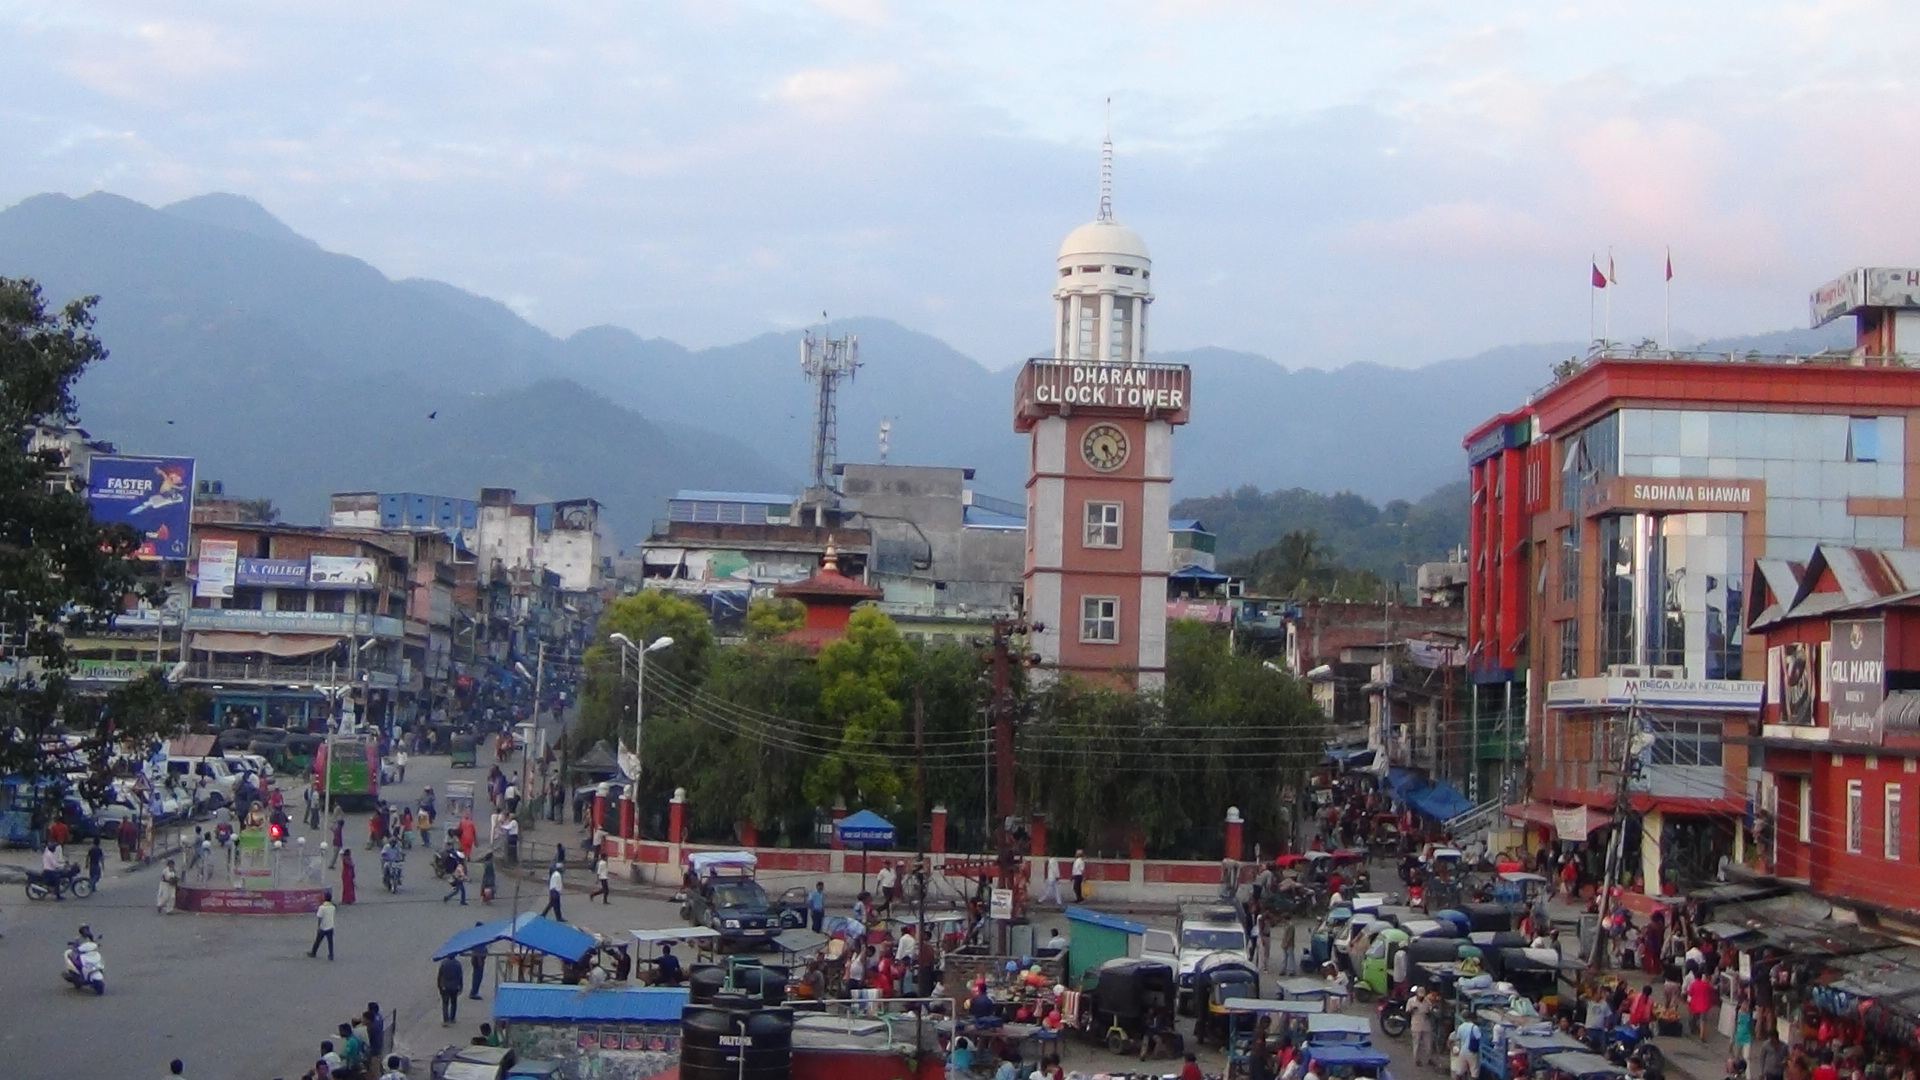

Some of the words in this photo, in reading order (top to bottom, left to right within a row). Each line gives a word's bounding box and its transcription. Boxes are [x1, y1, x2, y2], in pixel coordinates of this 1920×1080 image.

[1073, 366, 1147, 386] DHARAN
[1036, 384, 1106, 404] CLOCK
[1114, 387, 1183, 407] TOWER
[107, 478, 153, 491] FASTER
[1634, 484, 1694, 501] SADHANA
[1697, 486, 1751, 503] BHAWAN
[260, 564, 307, 577] COLLEGE
[1831, 660, 1848, 683] GILL
[1849, 660, 1882, 684] MARRY
[1639, 680, 1670, 690] MEGA
[1672, 681, 1697, 690] BANK
